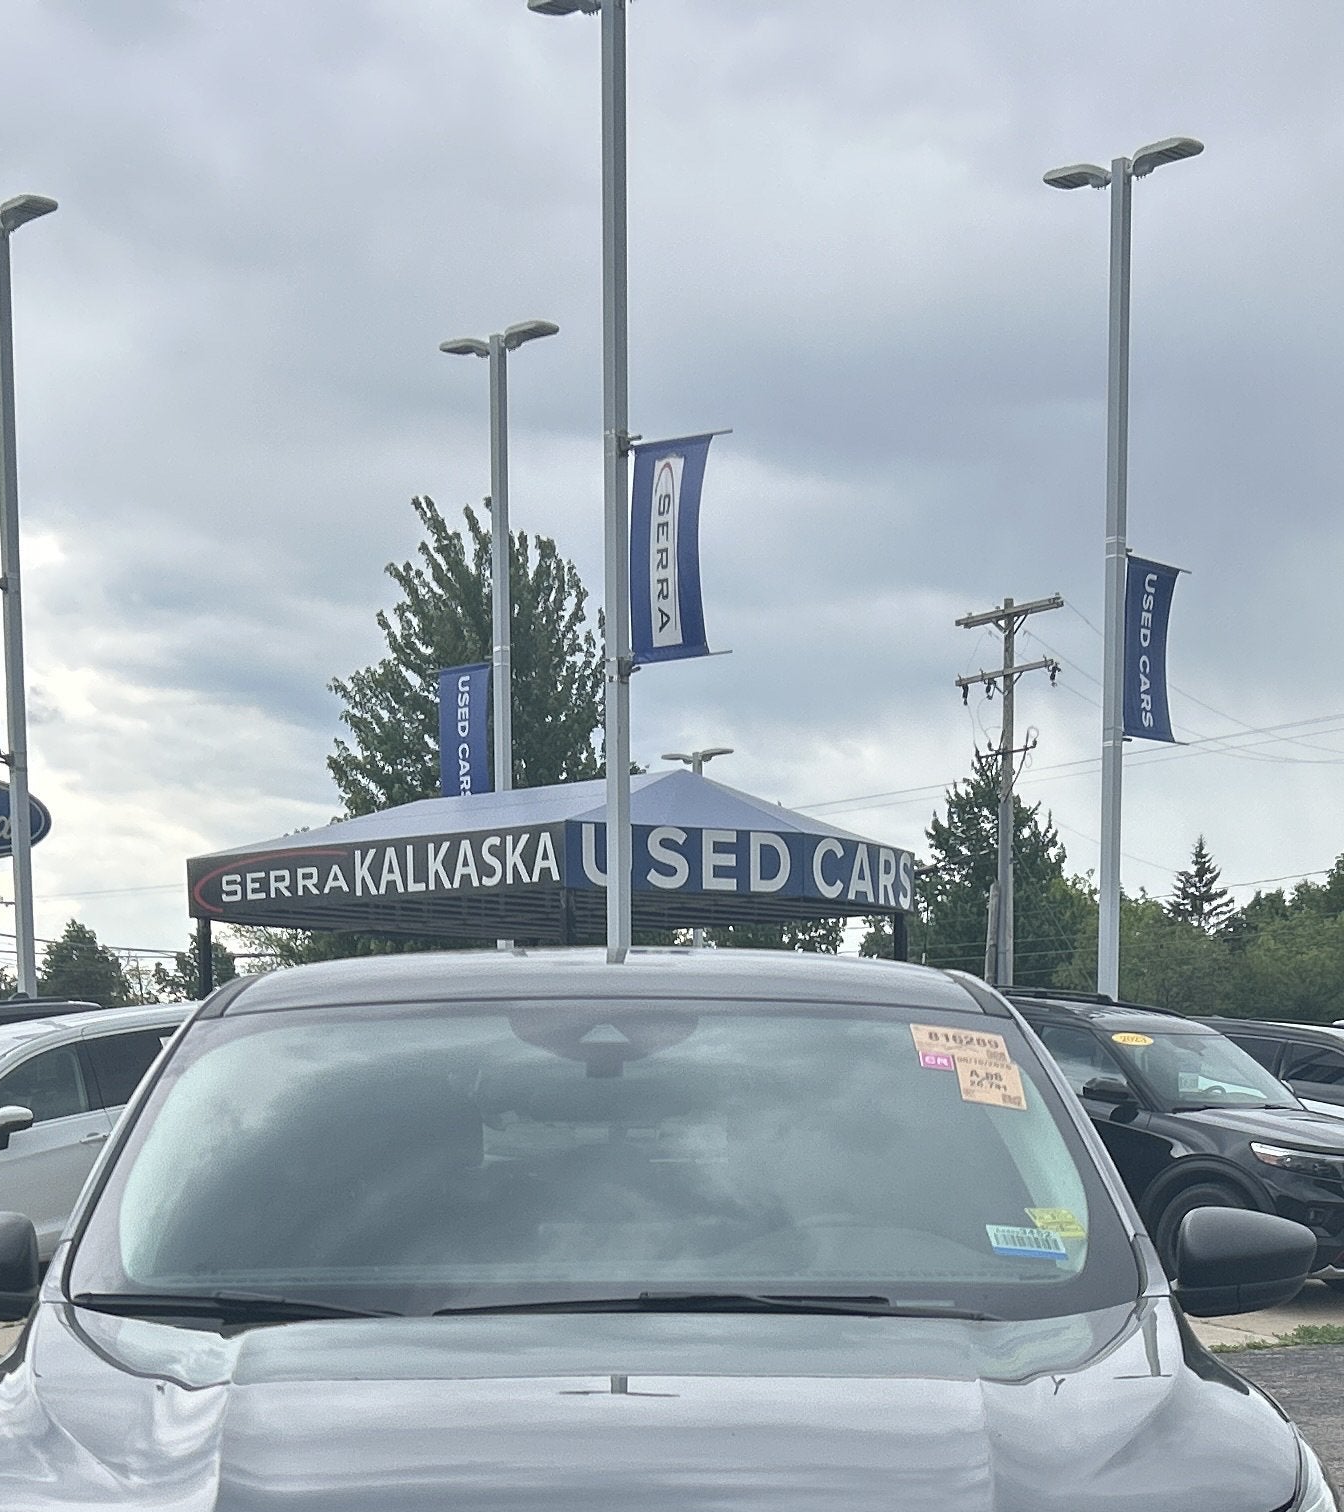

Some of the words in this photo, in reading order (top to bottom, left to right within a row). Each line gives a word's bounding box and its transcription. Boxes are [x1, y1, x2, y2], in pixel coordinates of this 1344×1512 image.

[656, 493, 671, 633] SERRA
[1139, 573, 1158, 648] USED
[457, 675, 471, 738] USED
[1139, 654, 1154, 728] CARS
[221, 864, 350, 902] SERRA
[354, 831, 560, 897] KALKASKA
[812, 837, 914, 911] CARS
